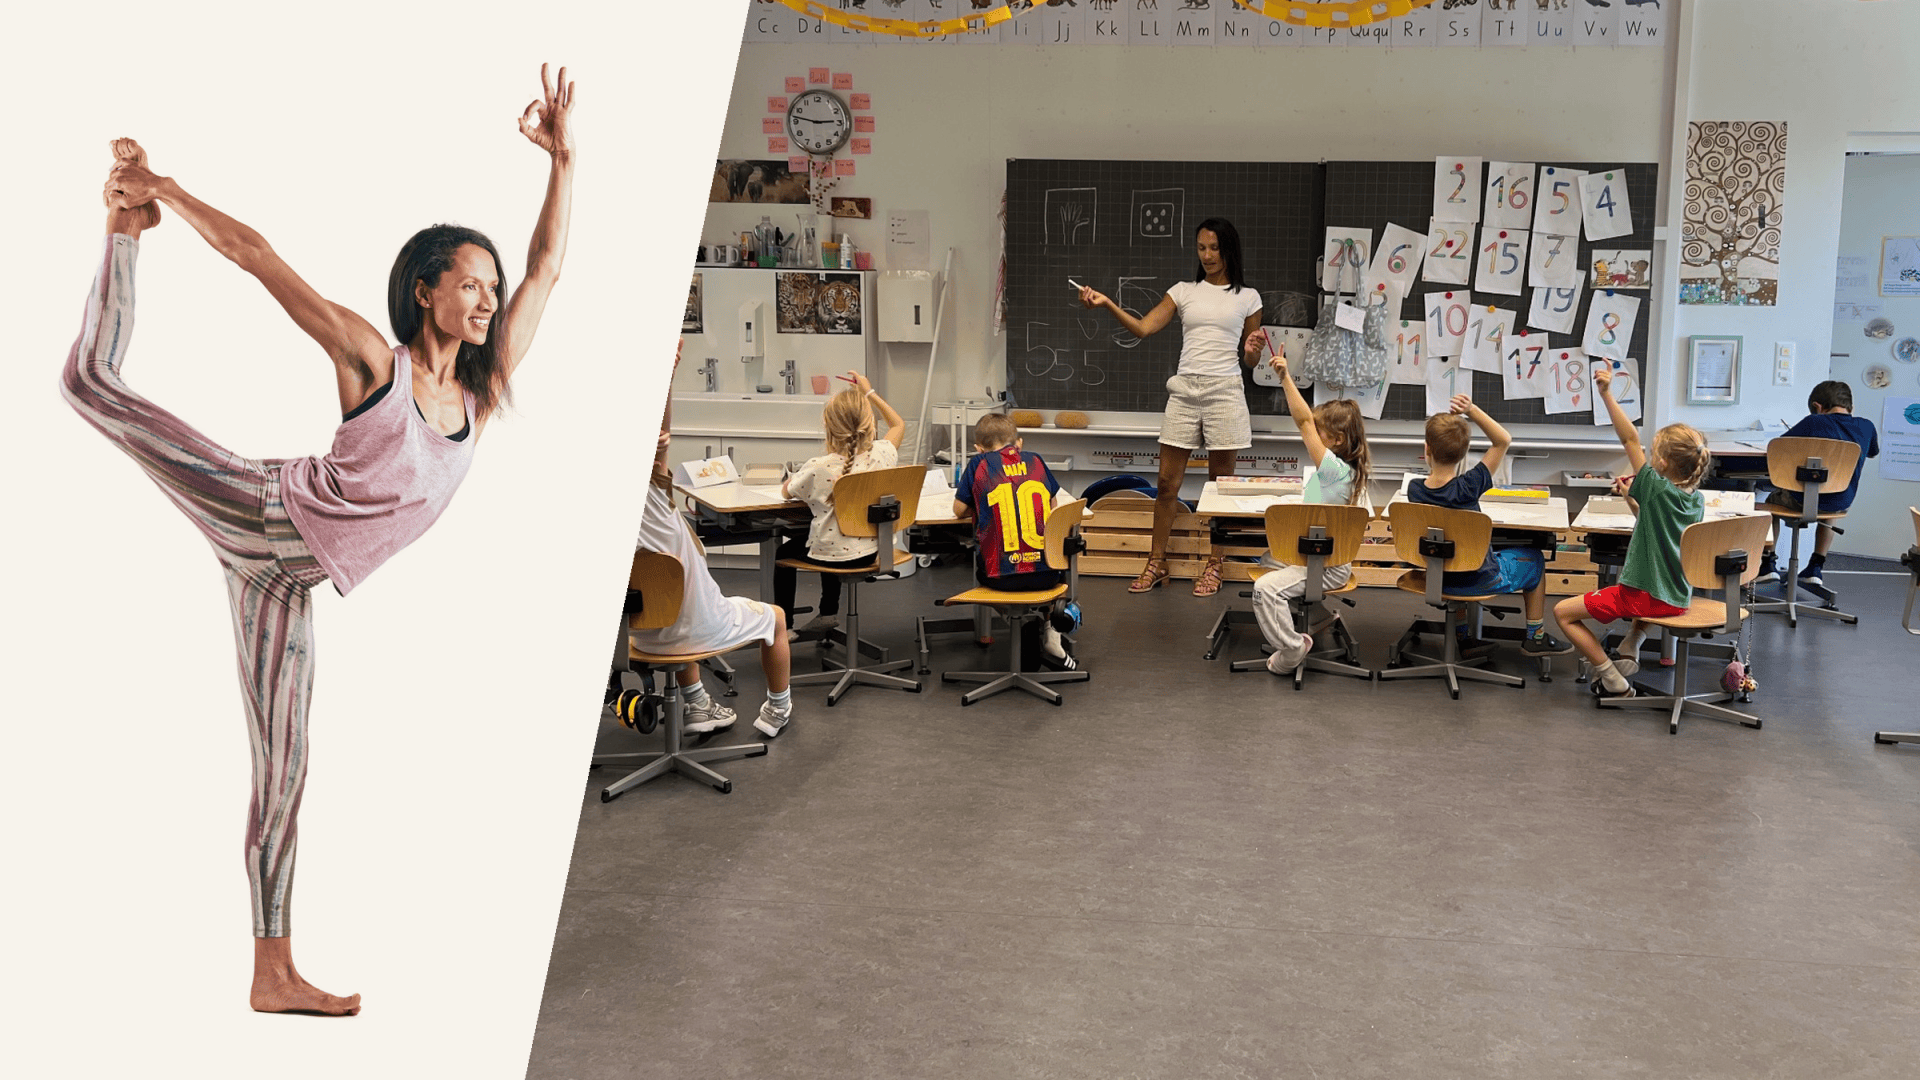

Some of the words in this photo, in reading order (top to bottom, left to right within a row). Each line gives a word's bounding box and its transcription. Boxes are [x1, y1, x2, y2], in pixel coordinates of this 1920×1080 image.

[1447, 169, 1466, 204] 2
[1491, 175, 1529, 210] 16
[1550, 181, 1570, 215] 5
[1596, 185, 1617, 218] 4
[1328, 239, 1367, 268] 20
[1387, 244, 1412, 274] 6
[1430, 229, 1469, 260] 22
[1484, 241, 1519, 275] 15
[1546, 235, 1566, 269] 7
[1430, 304, 1468, 338] 10
[1470, 318, 1504, 353] 14
[1599, 313, 1621, 345] 8
[1396, 333, 1421, 366] 11
[1508, 346, 1543, 380] 17
[1550, 360, 1584, 394] 18
[987, 480, 1051, 552] 10
